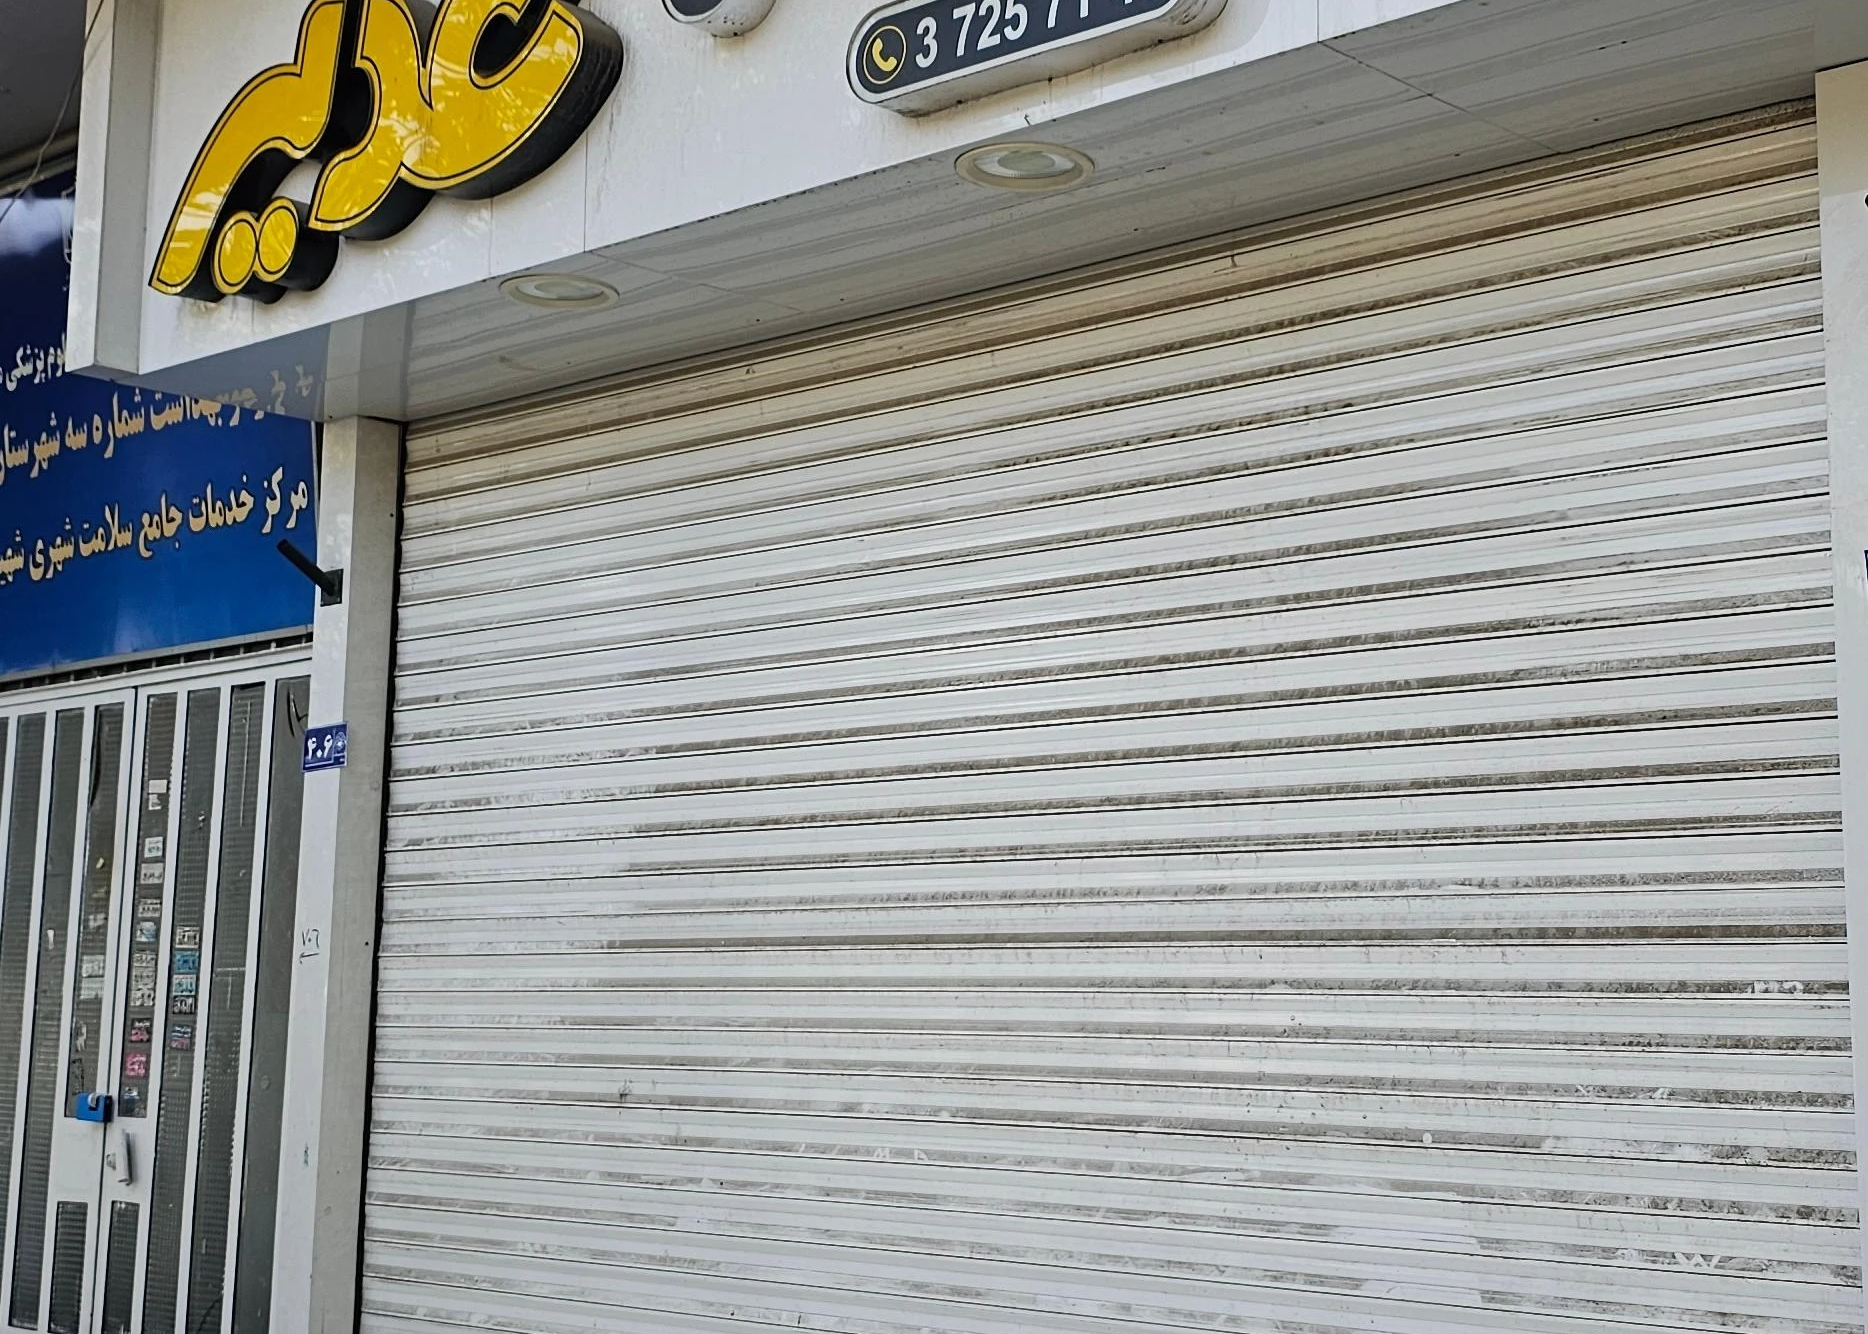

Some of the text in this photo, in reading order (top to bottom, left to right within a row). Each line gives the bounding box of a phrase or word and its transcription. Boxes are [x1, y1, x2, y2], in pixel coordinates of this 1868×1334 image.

[915, 16, 939, 69] 3
[65, 417, 87, 451] سه
[93, 388, 145, 459] شماره
[79, 502, 133, 556] سلامت
[139, 493, 183, 558] جامع
[188, 475, 255, 532] خدمات
[262, 467, 308, 534] مرکز
[29, 518, 75, 581] شهری
